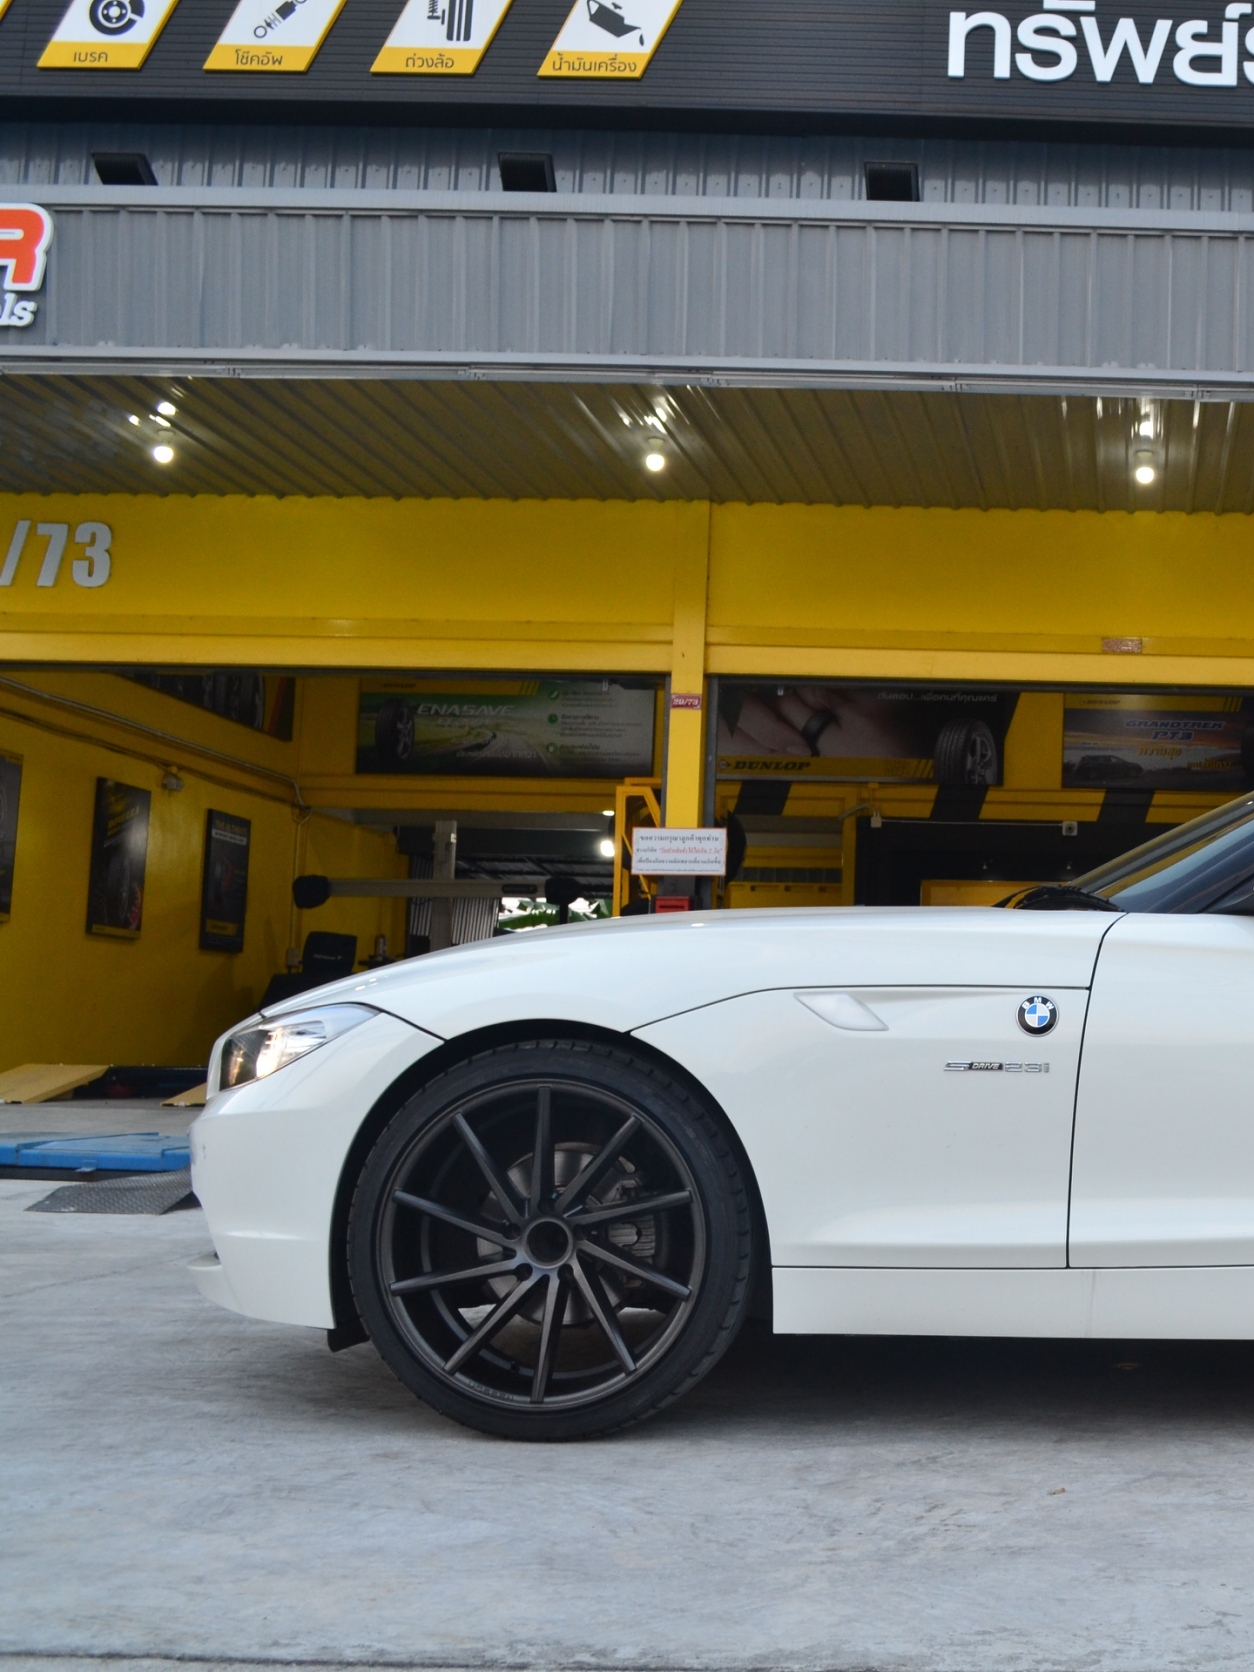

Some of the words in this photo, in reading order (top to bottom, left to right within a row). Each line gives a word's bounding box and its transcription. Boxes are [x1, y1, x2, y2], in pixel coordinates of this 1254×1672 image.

[73, 51, 109, 63] เบรค
[405, 52, 455, 69] ถ่วงล้อ
[552, 52, 637, 73] น้ำมันเครื่อง
[417, 703, 515, 716] ENASAVE
[733, 760, 811, 771] DUNLOP
